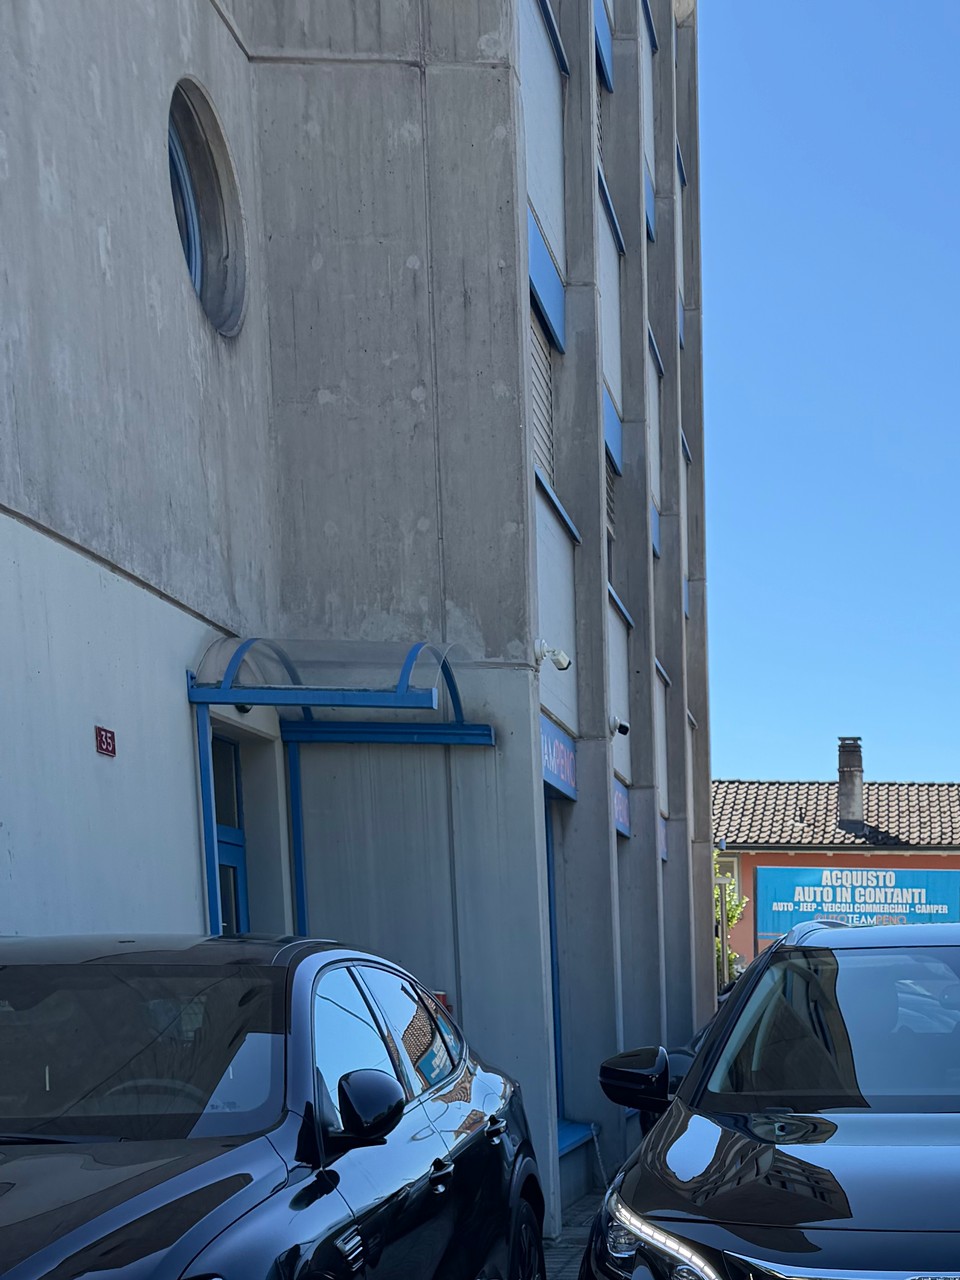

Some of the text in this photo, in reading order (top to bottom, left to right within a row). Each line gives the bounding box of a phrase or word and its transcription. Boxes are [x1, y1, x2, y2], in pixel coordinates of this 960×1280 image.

[101, 731, 112, 751] 35
[821, 870, 896, 888] ACQUISTO
[794, 886, 926, 904] AUTO IN CONTANTI
[772, 901, 794, 912] AUTO
[799, 902, 817, 912] JEEP
[822, 903, 853, 913] VEICOLI
[854, 903, 910, 914] COMMERCIALI
[915, 904, 949, 914] CAMPER
